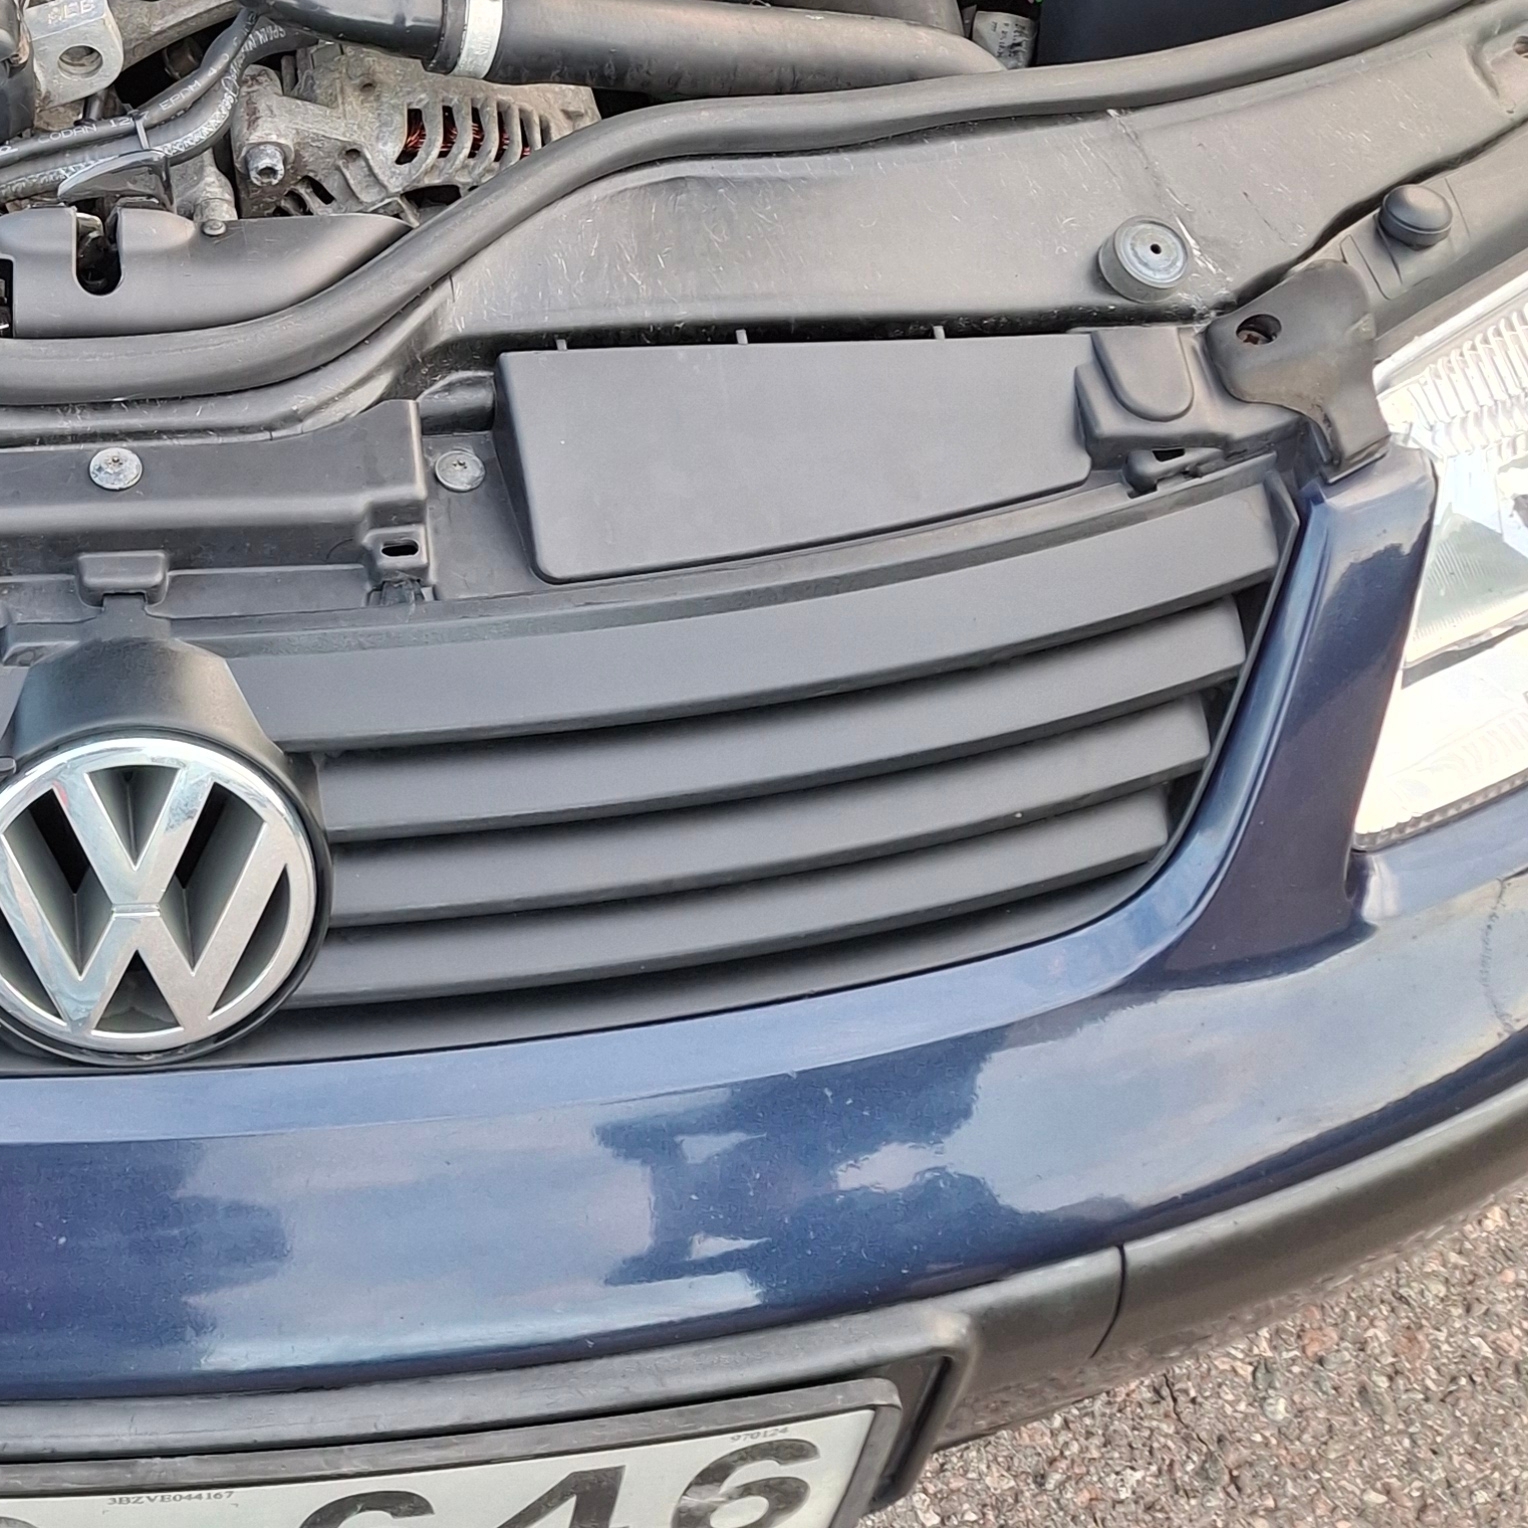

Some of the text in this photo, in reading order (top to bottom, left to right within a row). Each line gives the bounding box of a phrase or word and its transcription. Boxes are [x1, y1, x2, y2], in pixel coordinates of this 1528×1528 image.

[38, 123, 98, 144] CODAN
[158, 79, 201, 111] EPDM
[106, 1490, 235, 1506] 3BZVE044167
